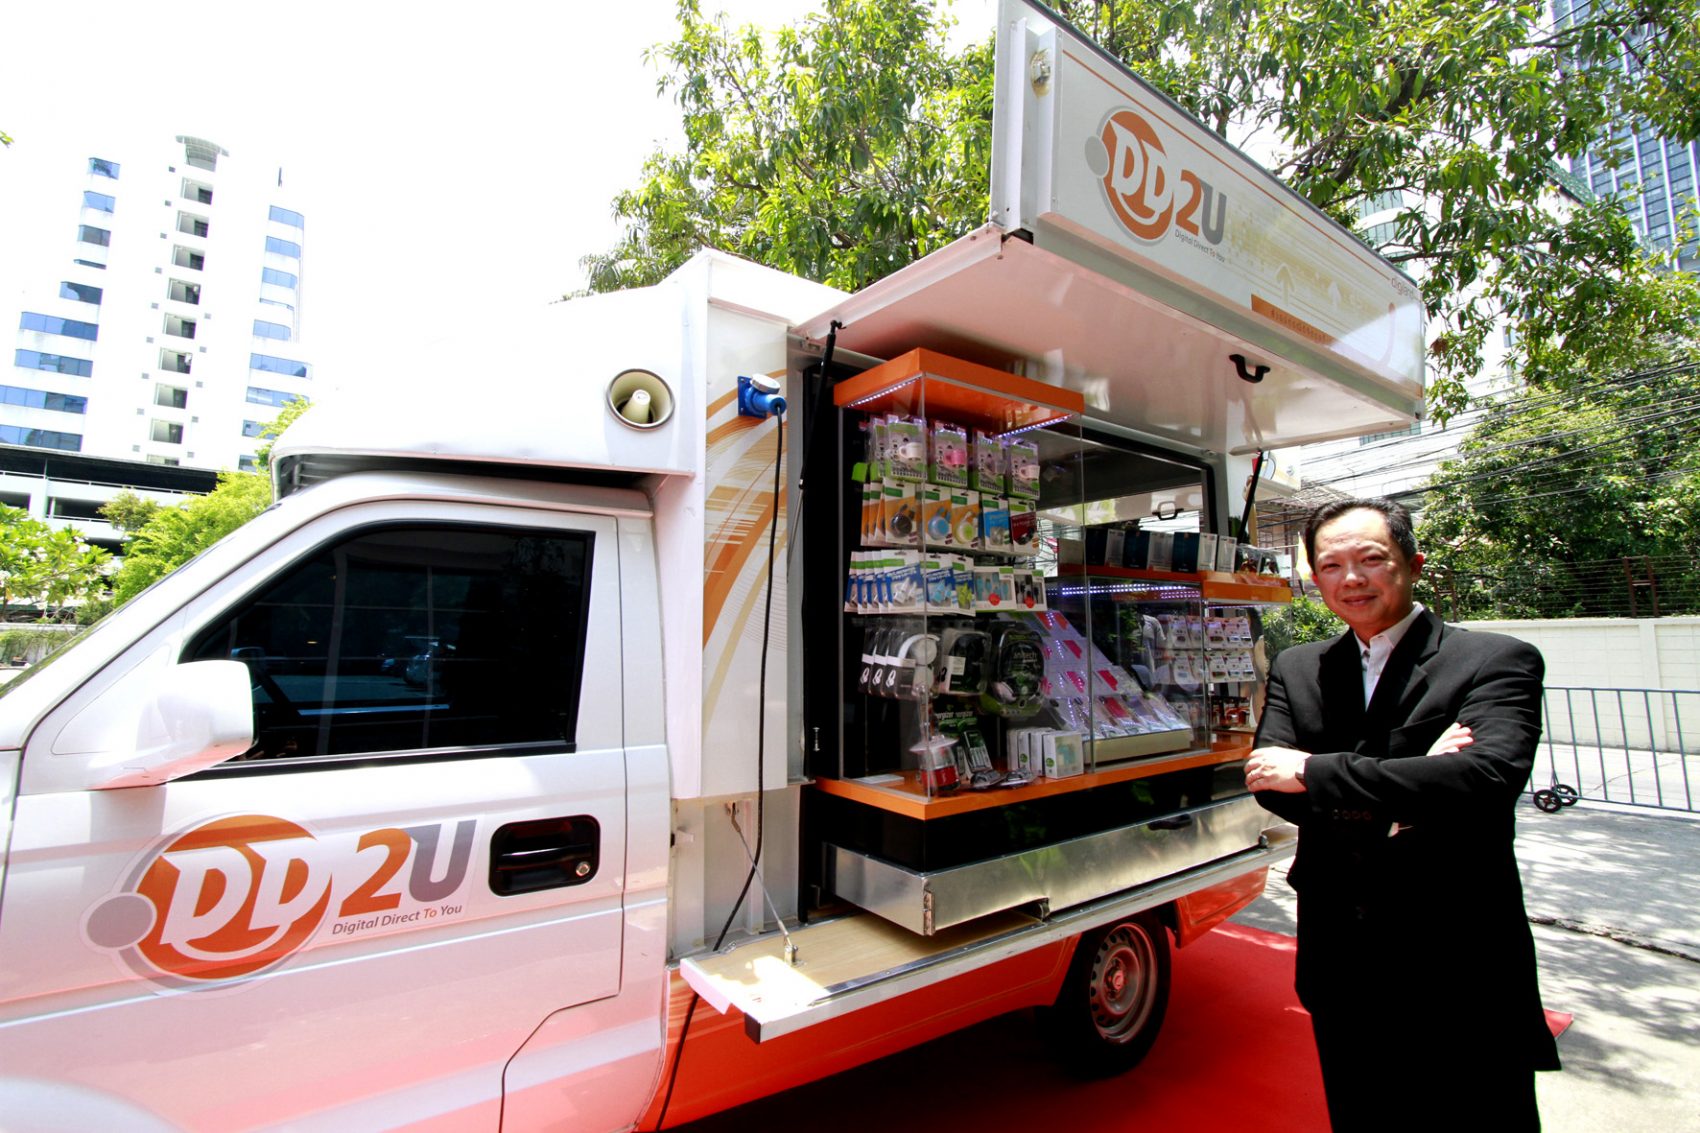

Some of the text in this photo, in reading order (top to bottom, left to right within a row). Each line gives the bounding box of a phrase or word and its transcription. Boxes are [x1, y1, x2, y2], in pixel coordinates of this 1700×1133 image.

[1109, 119, 1227, 245] DD2U
[160, 819, 477, 958] DD2U
[332, 905, 462, 935] Digital Direct To You
